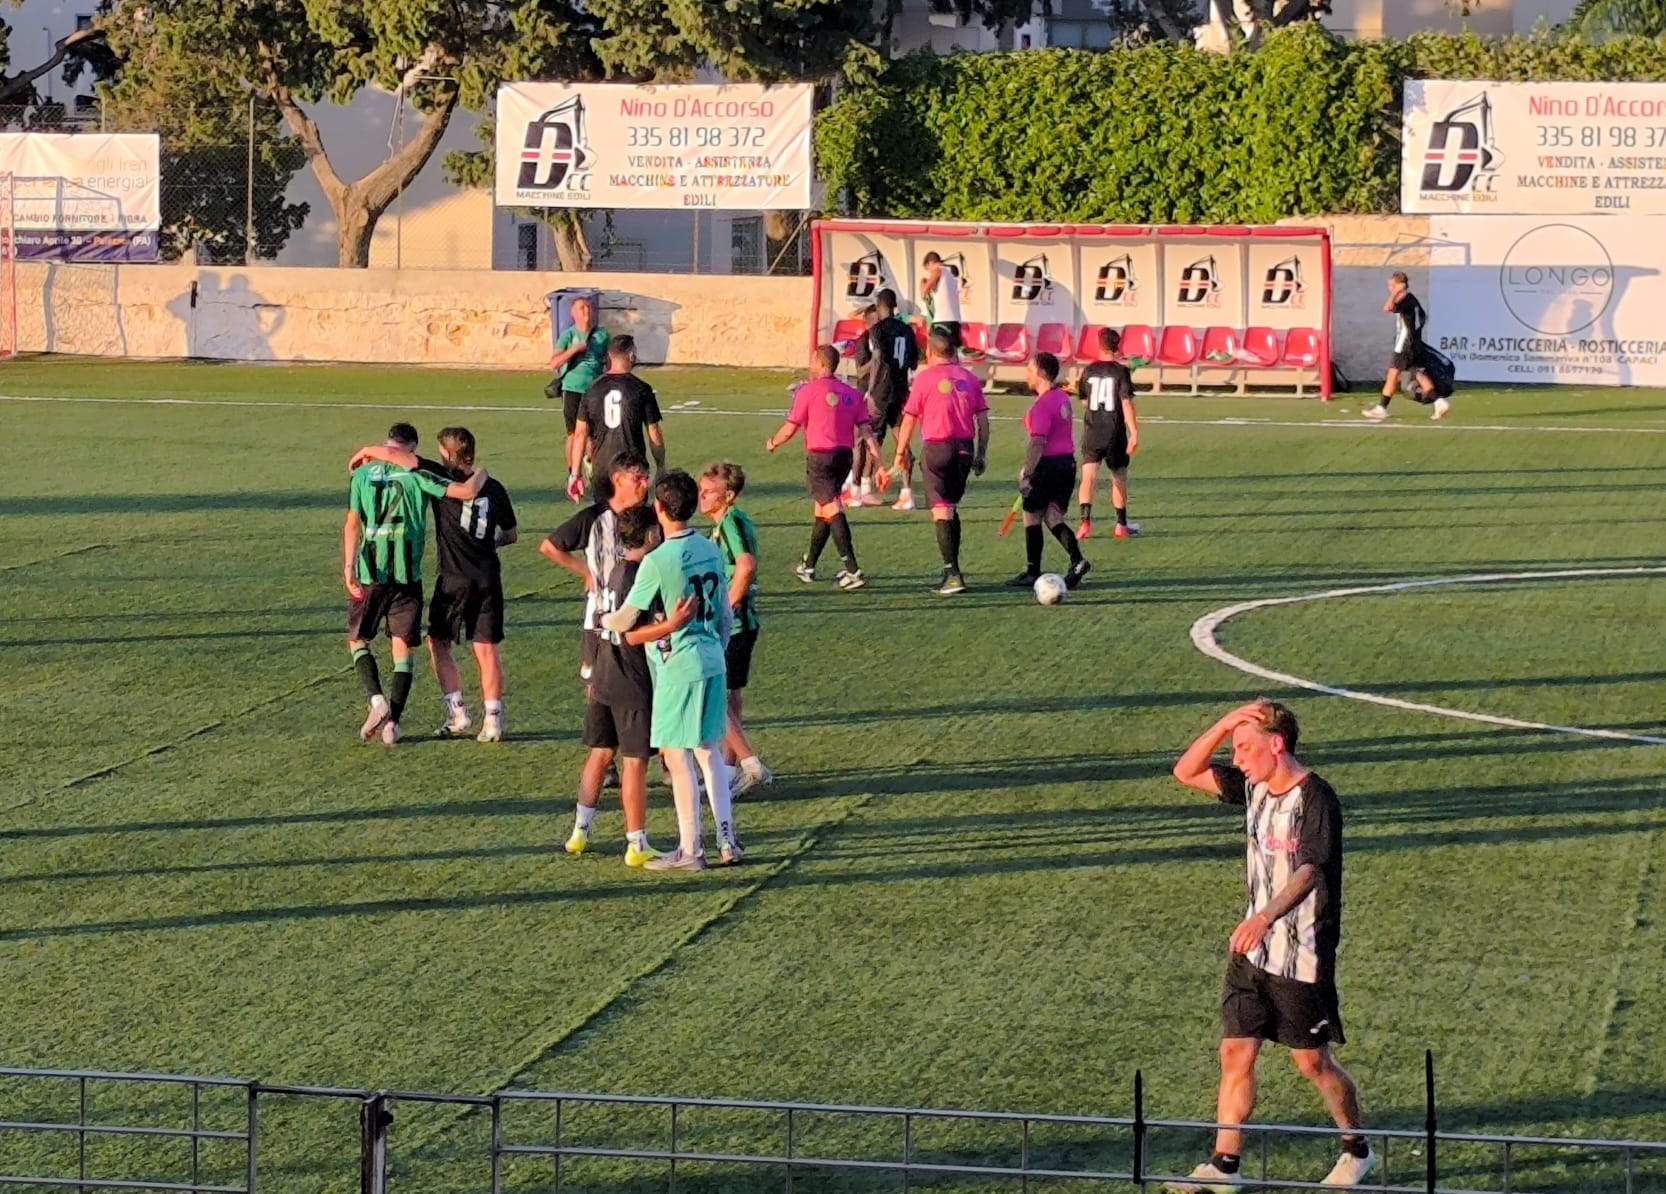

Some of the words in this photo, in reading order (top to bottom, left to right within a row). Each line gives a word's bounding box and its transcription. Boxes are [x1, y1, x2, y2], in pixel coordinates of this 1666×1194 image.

[620, 98, 667, 118] Nino
[674, 95, 774, 118] D'Accorso
[1529, 95, 1577, 117] Nino
[627, 126, 663, 147] 335
[670, 126, 689, 147] 81
[696, 126, 721, 147] 98
[728, 126, 766, 147] 372
[1537, 125, 1574, 147] 335
[1581, 125, 1601, 147] 81
[1609, 126, 1637, 148] 98
[628, 155, 683, 168] VENDITA
[1537, 155, 1595, 169] VENDITA
[1608, 156, 1666, 169] ASSISTE
[680, 174, 687, 187] E
[1517, 175, 1587, 188] MACCHINE
[1591, 176, 1600, 189] E
[1604, 175, 1666, 189] ATTREZZ
[683, 194, 716, 206] EDILI
[1594, 195, 1630, 209] EDILI
[1508, 266, 1611, 287] LONGO
[1440, 336, 1468, 351] BAR
[1478, 337, 1568, 353] PASTICCERIA
[1087, 376, 1115, 411] 14
[604, 389, 621, 428] 6
[369, 480, 404, 527] 12
